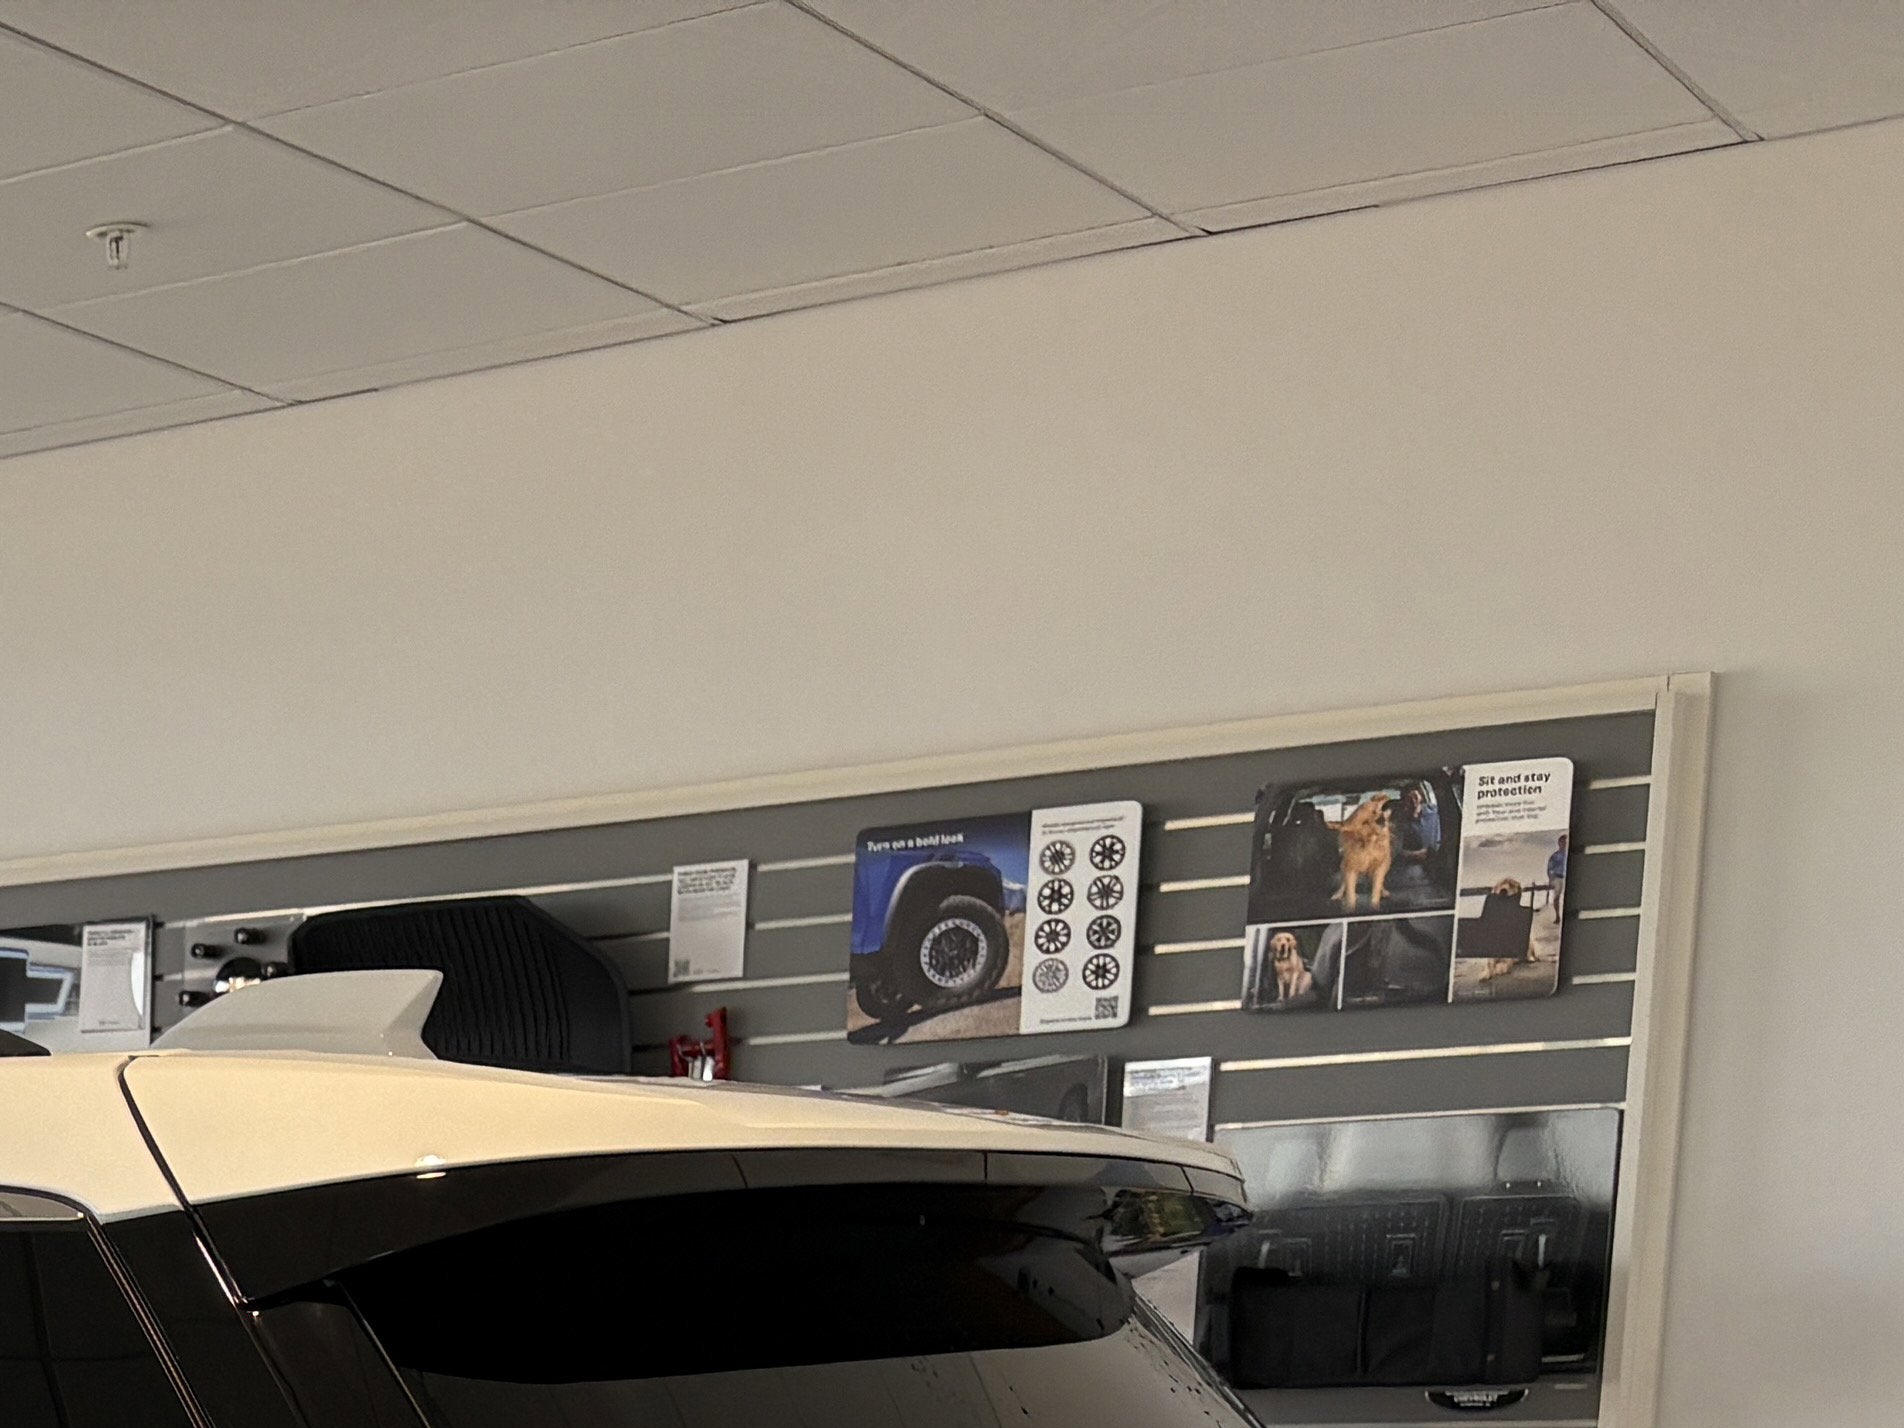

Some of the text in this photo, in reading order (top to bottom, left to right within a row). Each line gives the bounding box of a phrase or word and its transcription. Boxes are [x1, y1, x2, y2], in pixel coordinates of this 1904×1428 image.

[1477, 772, 1552, 787] Sit and stay
[1477, 785, 1543, 801] protection
